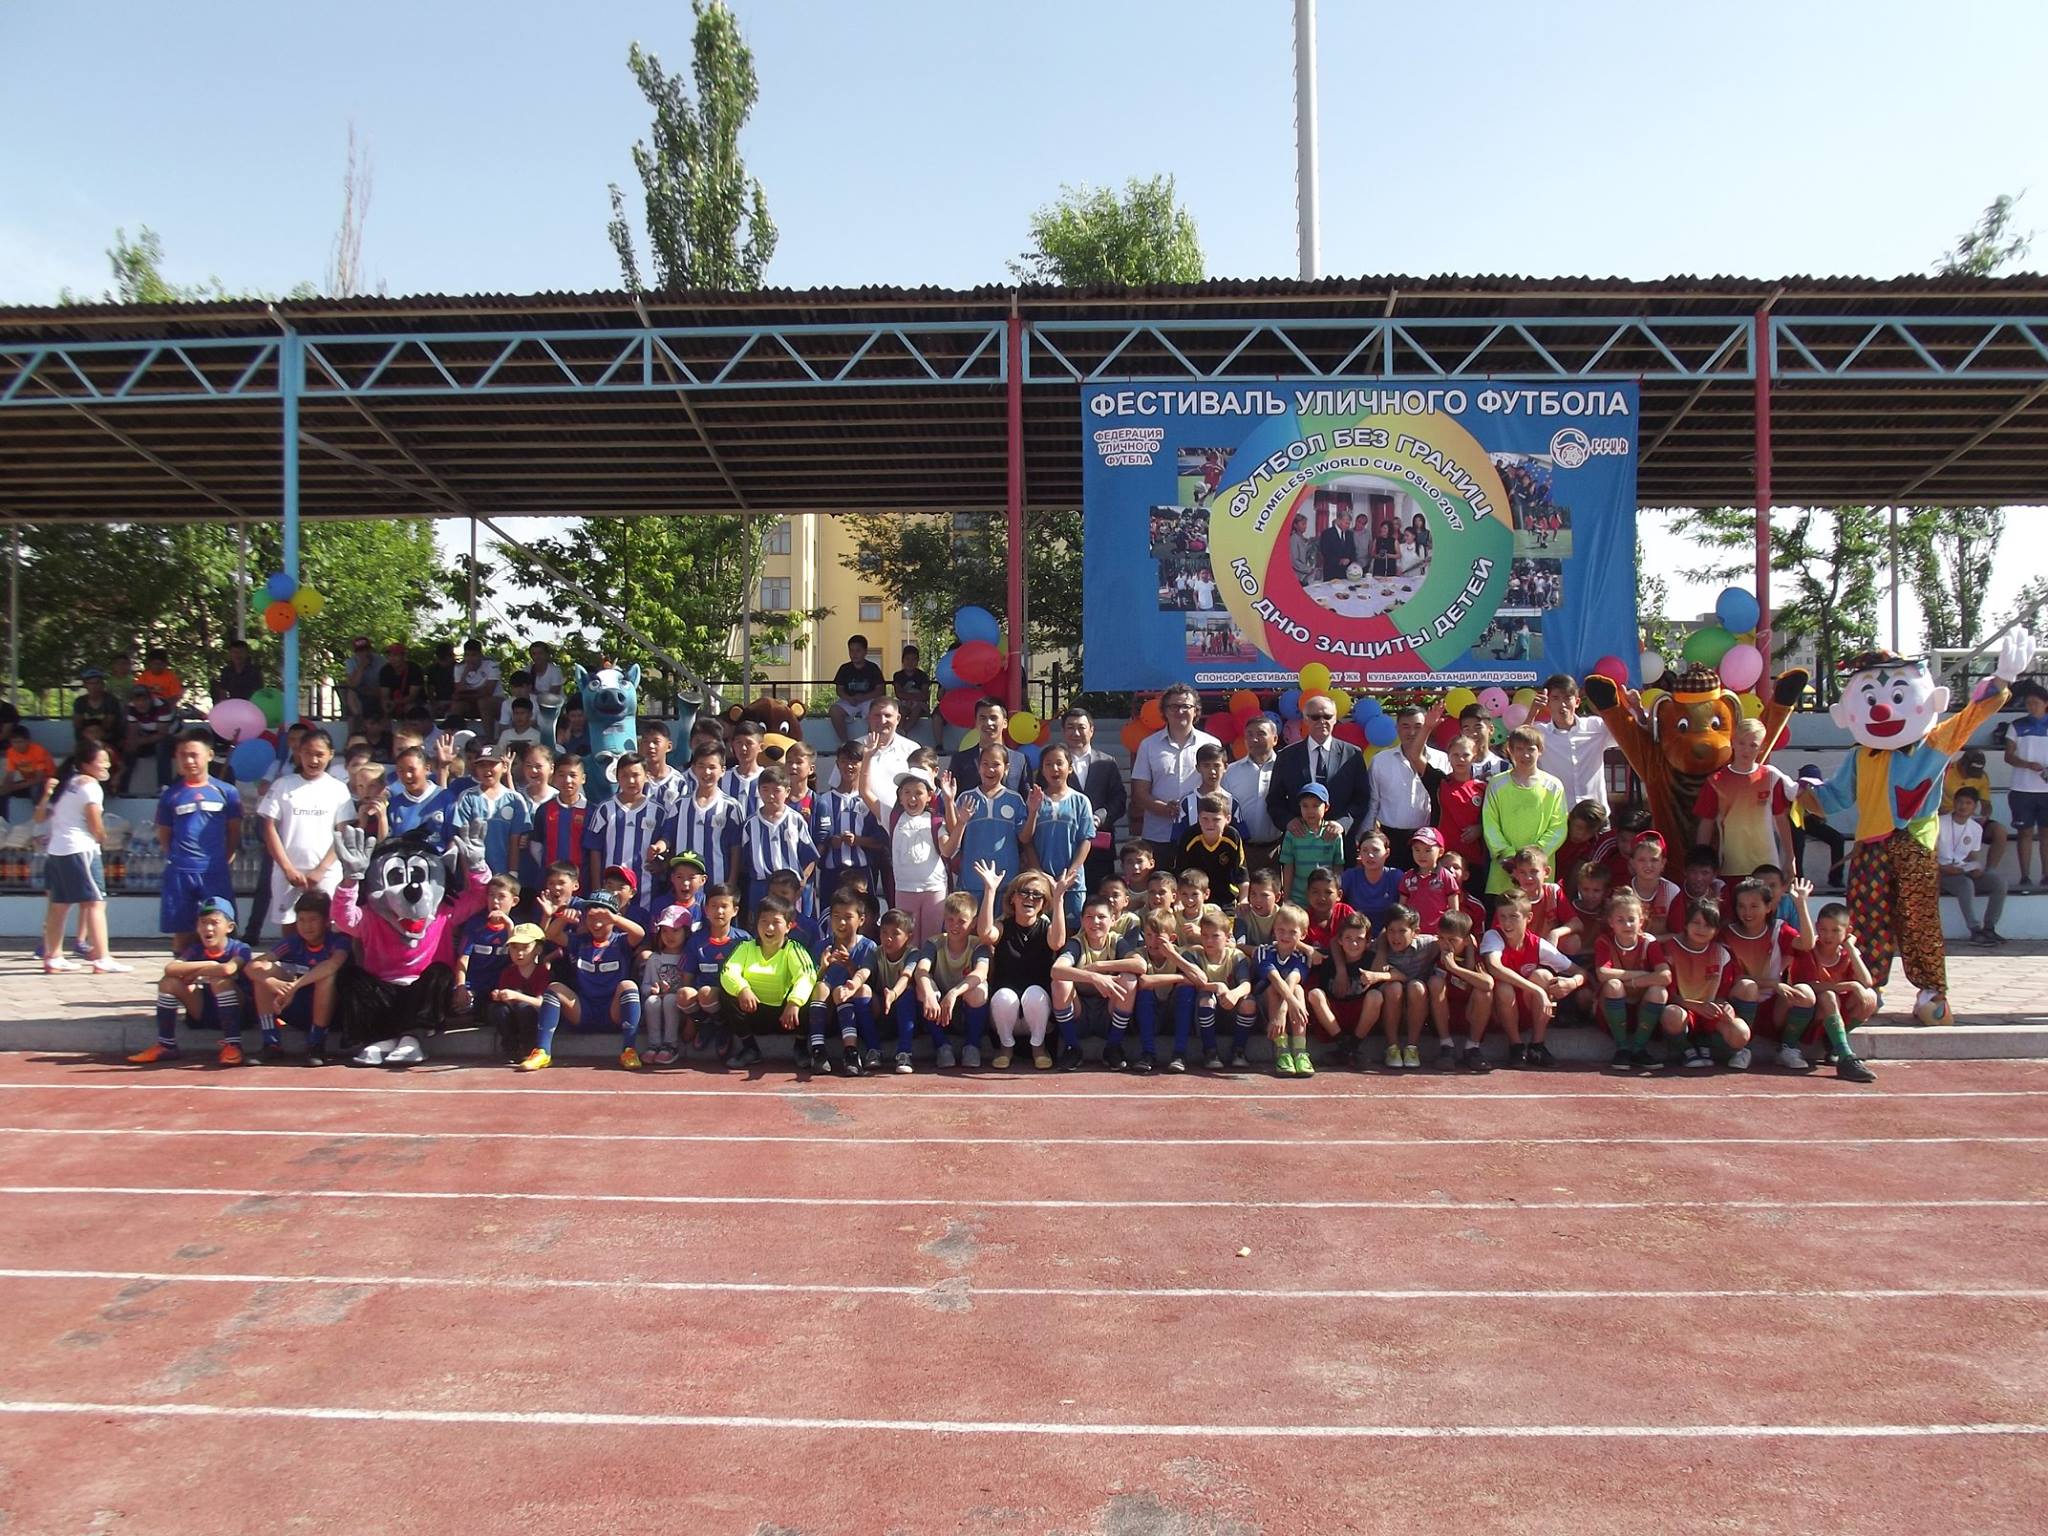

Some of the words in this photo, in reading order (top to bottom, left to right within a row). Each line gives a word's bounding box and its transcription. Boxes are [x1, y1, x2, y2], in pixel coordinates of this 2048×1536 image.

[1090, 390, 1286, 416] ФЕСТИВАЛЬ
[1296, 389, 1467, 416] УЛИЧНОГО
[1477, 389, 1629, 416] ФУТБОЛА
[1095, 429, 1163, 441] ФЕДЕРАЦИЯ
[1099, 442, 1158, 453] УЛИЧНОГО
[1106, 455, 1151, 465] ФУТБЛА
[1229, 433, 1327, 518] ФУТБОЛ
[1333, 428, 1390, 448] БЕЗ
[1395, 434, 1493, 521] ГРАНИЦ
[1254, 469, 1314, 532] HOMELESS
[1317, 457, 1369, 473] WORLD
[1373, 458, 1403, 473] CUP
[1404, 469, 1441, 500] OSLO
[1440, 497, 1463, 531] 2017
[1231, 557, 1258, 596] КО
[1252, 598, 1311, 643] ДНЮ
[1315, 627, 1432, 660] ЗАЩИТЫ
[1433, 556, 1494, 639] ДЕТЕЙ
[1196, 673, 1241, 682] СПОНСОР
[1242, 672, 1299, 681] ФЕСТИВАЛЯ
[1368, 673, 1427, 681] КУЛБАРАКОВ
[1480, 672, 1536, 681] ИЛДУЗОВИЧ
